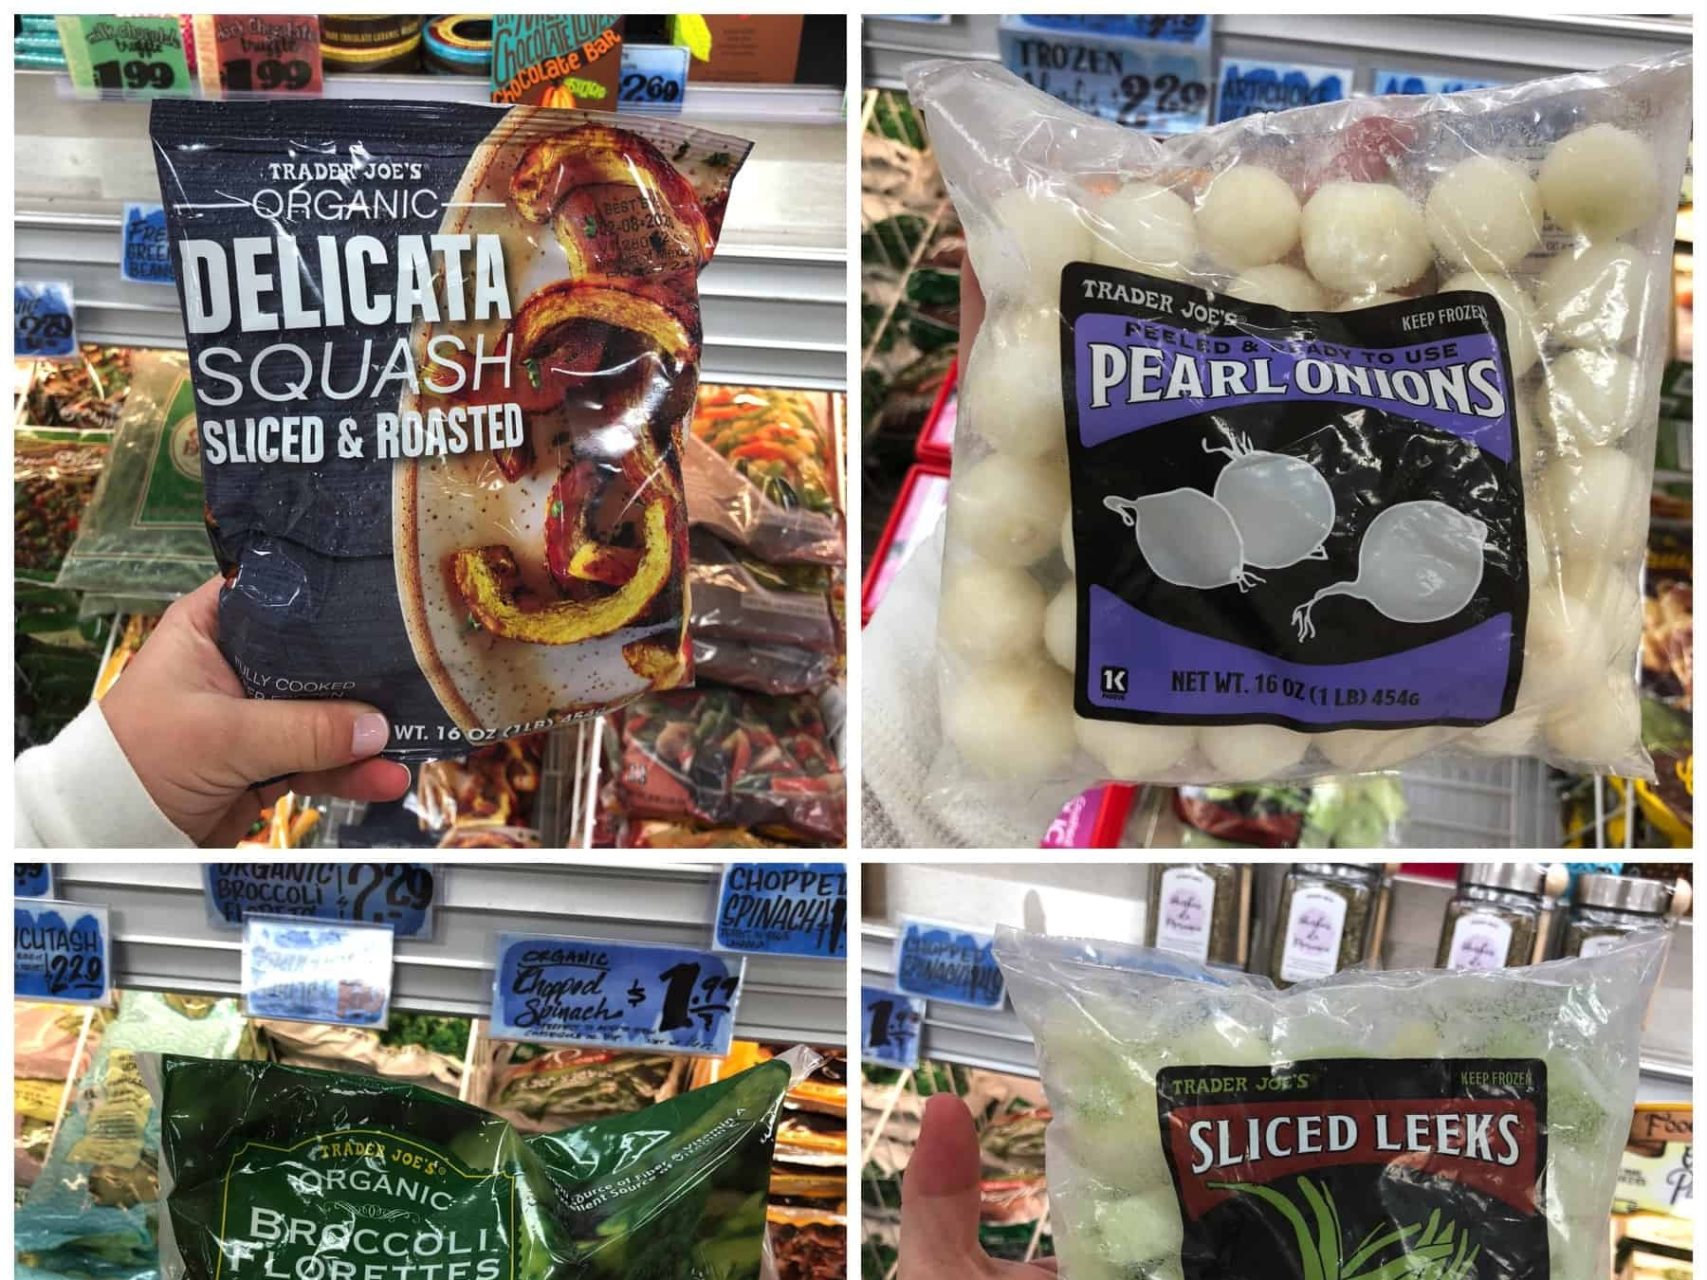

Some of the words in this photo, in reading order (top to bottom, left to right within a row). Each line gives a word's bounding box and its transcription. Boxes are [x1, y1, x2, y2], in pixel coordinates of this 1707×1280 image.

[268, 162, 357, 180] TRADER
[363, 162, 422, 180] JOE'S
[253, 188, 438, 220] ORGANIC
[179, 234, 512, 334] DELICATA
[1081, 279, 1173, 313] TRADER
[1181, 300, 1238, 327] JOE'S
[1402, 314, 1435, 331] KEEP
[1438, 304, 1487, 323] FROZEN
[1125, 321, 1230, 354] PEELED
[1241, 339, 1259, 353] &
[1361, 351, 1394, 364] TO
[1406, 343, 1458, 364] USE
[197, 333, 514, 406] SQUASH
[1088, 342, 1288, 410] PEARL
[1294, 356, 1506, 419] ONIONS
[203, 415, 324, 465] SLICED
[337, 417, 365, 459] &
[376, 402, 525, 459] ROASTED
[275, 677, 356, 692] COOKED
[1172, 671, 1210, 692] NET
[1215, 672, 1249, 694] WT.
[1255, 674, 1278, 694] 16
[1283, 679, 1305, 700] OZ
[1309, 687, 1329, 706] (1
[1334, 688, 1367, 706] LB)
[395, 725, 428, 741] WT.
[436, 724, 461, 741] 16
[468, 729, 496, 741] OZ
[521, 950, 610, 966] ORGANIC
[511, 966, 604, 998] Chopped
[514, 997, 624, 1029] Spinach
[1172, 1076, 1247, 1096] TRADER
[1256, 1073, 1309, 1092] JOE'S
[1461, 1071, 1489, 1086] KEEP
[1492, 1071, 1533, 1086] FROZEN
[319, 1141, 386, 1159] TRADER
[391, 1148, 438, 1176] JOE'S
[1189, 1114, 1358, 1175] SLICED
[1374, 1112, 1521, 1167] LEEKS
[299, 1169, 453, 1212] ORGANIC
[250, 1206, 499, 1257] BROCCOLI
